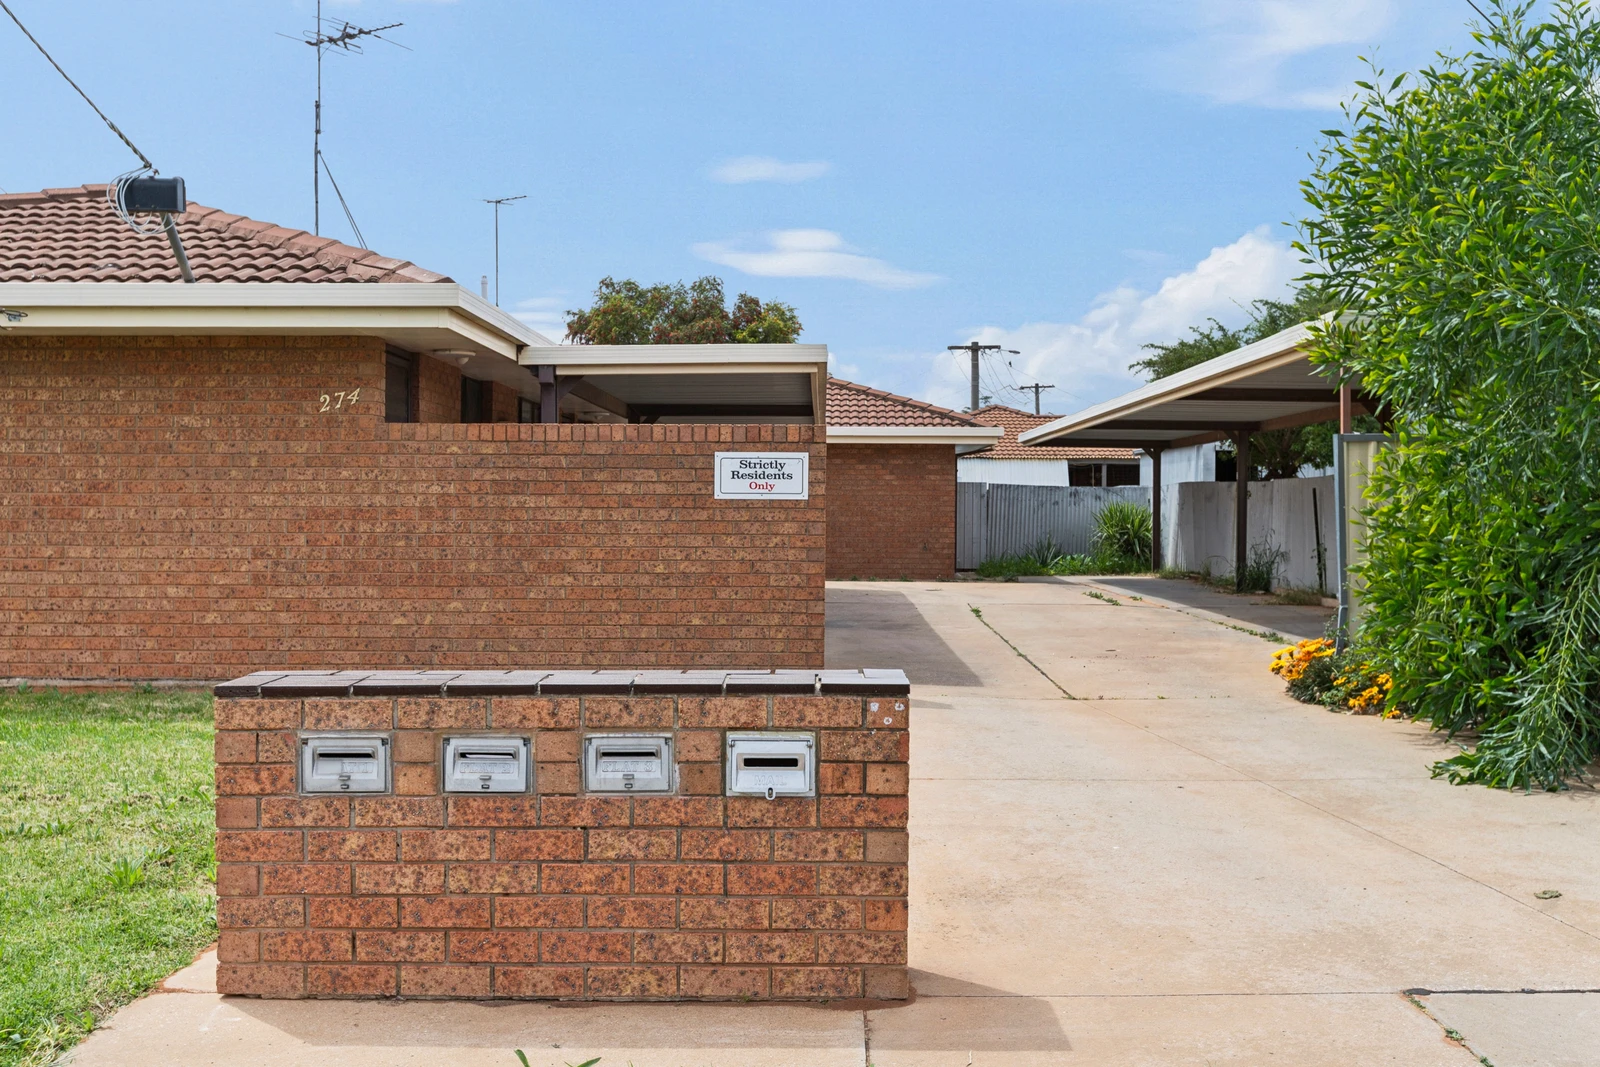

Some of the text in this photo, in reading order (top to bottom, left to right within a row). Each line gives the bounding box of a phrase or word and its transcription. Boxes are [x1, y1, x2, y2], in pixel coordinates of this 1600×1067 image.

[319, 387, 361, 413] 274
[739, 459, 786, 471] Strictly
[730, 470, 793, 480] Residents
[748, 481, 776, 492] Only
[459, 762, 512, 773] FLAT 2
[601, 760, 654, 772] FLAT 3
[753, 774, 787, 786] MAIL
